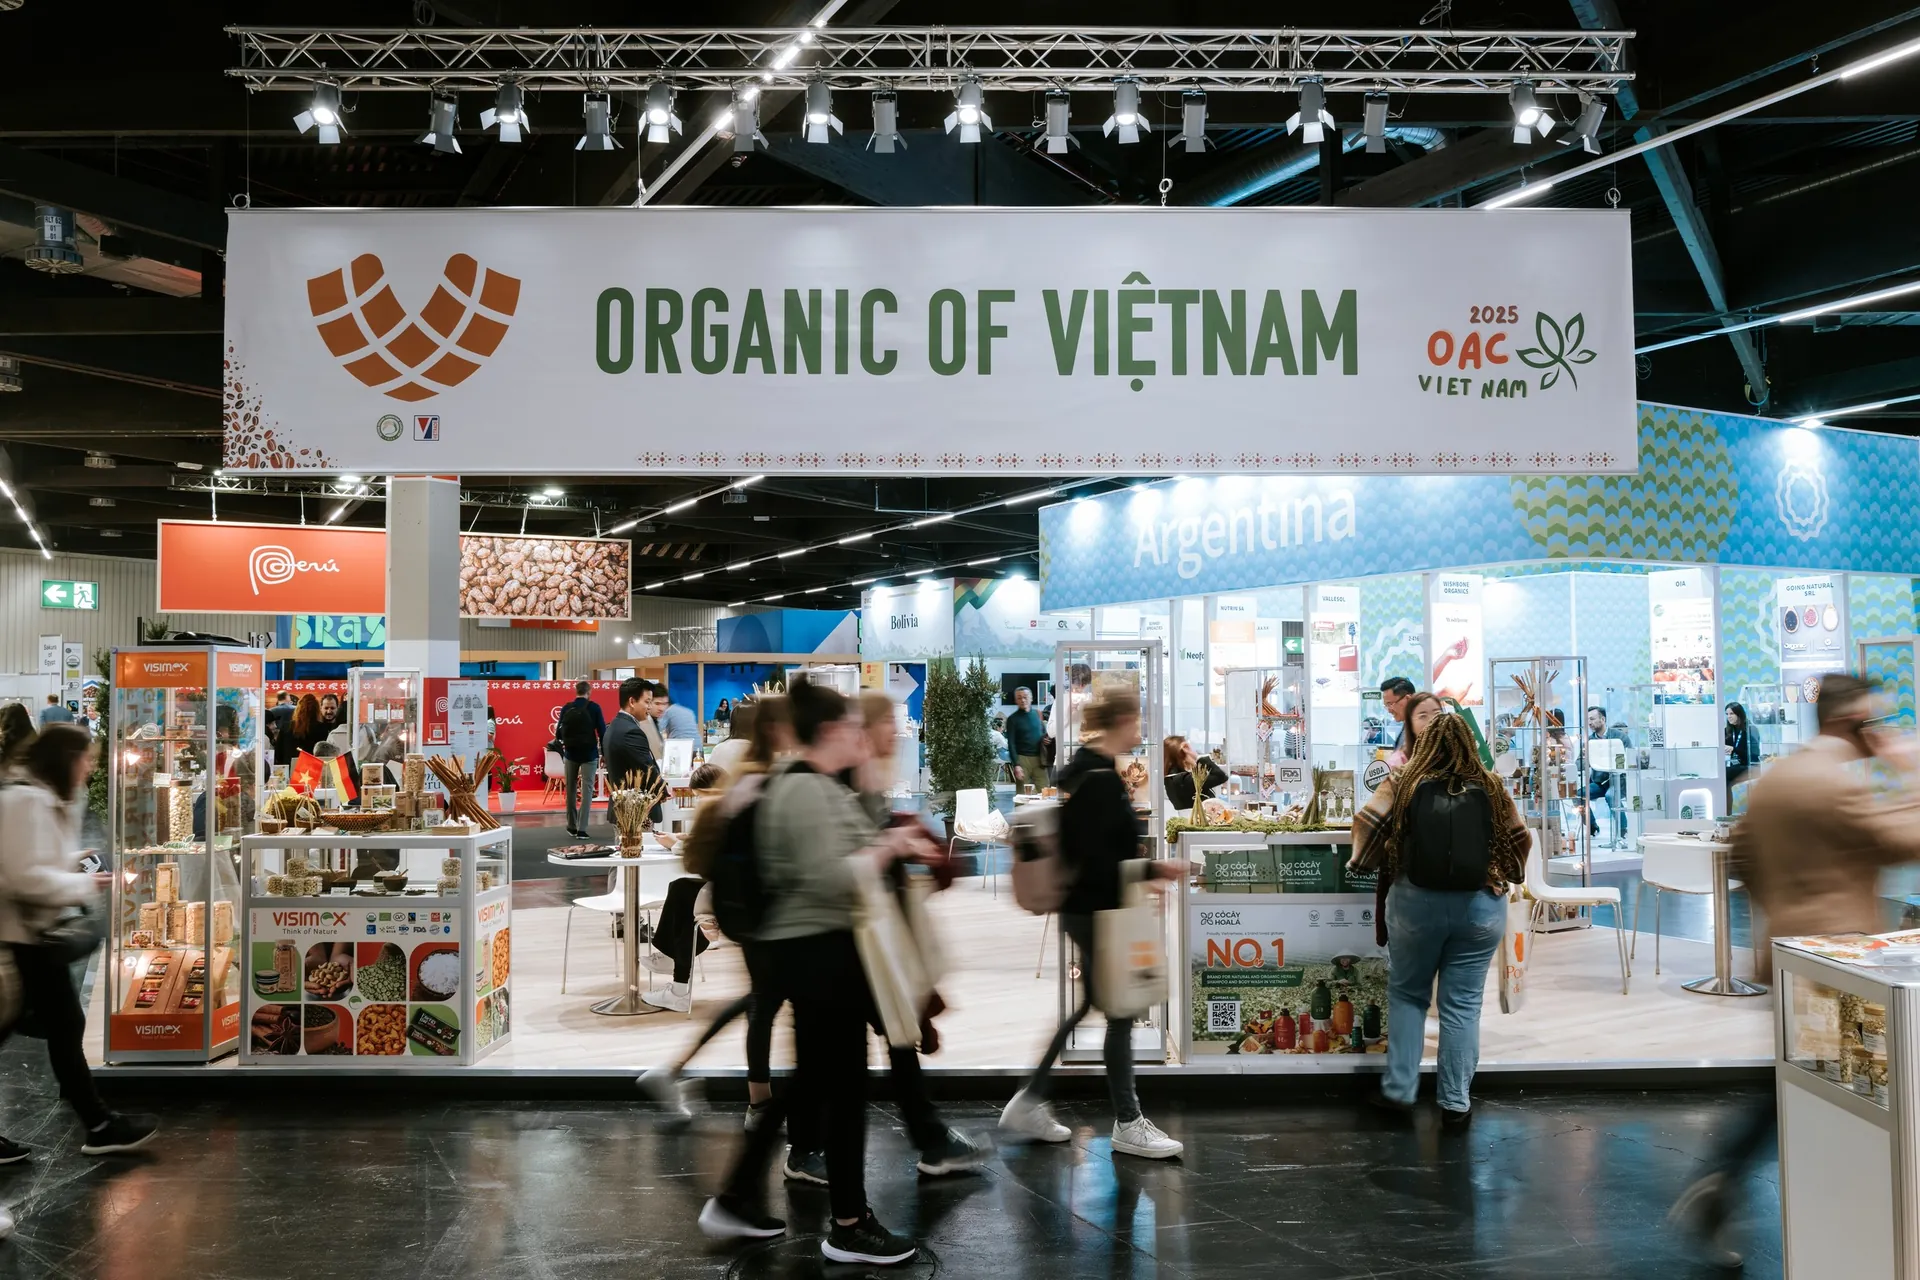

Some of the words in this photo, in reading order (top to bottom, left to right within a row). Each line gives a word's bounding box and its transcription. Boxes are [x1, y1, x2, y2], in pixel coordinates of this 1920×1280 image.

[1469, 305, 1519, 324] 2025
[595, 286, 898, 375] ORGANIC
[928, 288, 1016, 376] OF
[1042, 270, 1359, 393] VIỆTNAM
[1427, 330, 1509, 370] OAC
[1418, 374, 1472, 396] VIET
[1481, 378, 1527, 399] NAM
[1133, 488, 1356, 579] Argentina
[249, 544, 341, 596] Perú
[1322, 595, 1346, 603] VALLESOL
[890, 614, 919, 630] Bolivia
[143, 662, 189, 673] VISIMEX
[495, 715, 523, 725] erú
[1282, 769, 1299, 778] FDA
[1368, 766, 1385, 778] USDA
[272, 911, 347, 926] VISIMEX
[221, 1011, 240, 1027] VISIM
[135, 1024, 182, 1035] VISIMEX
